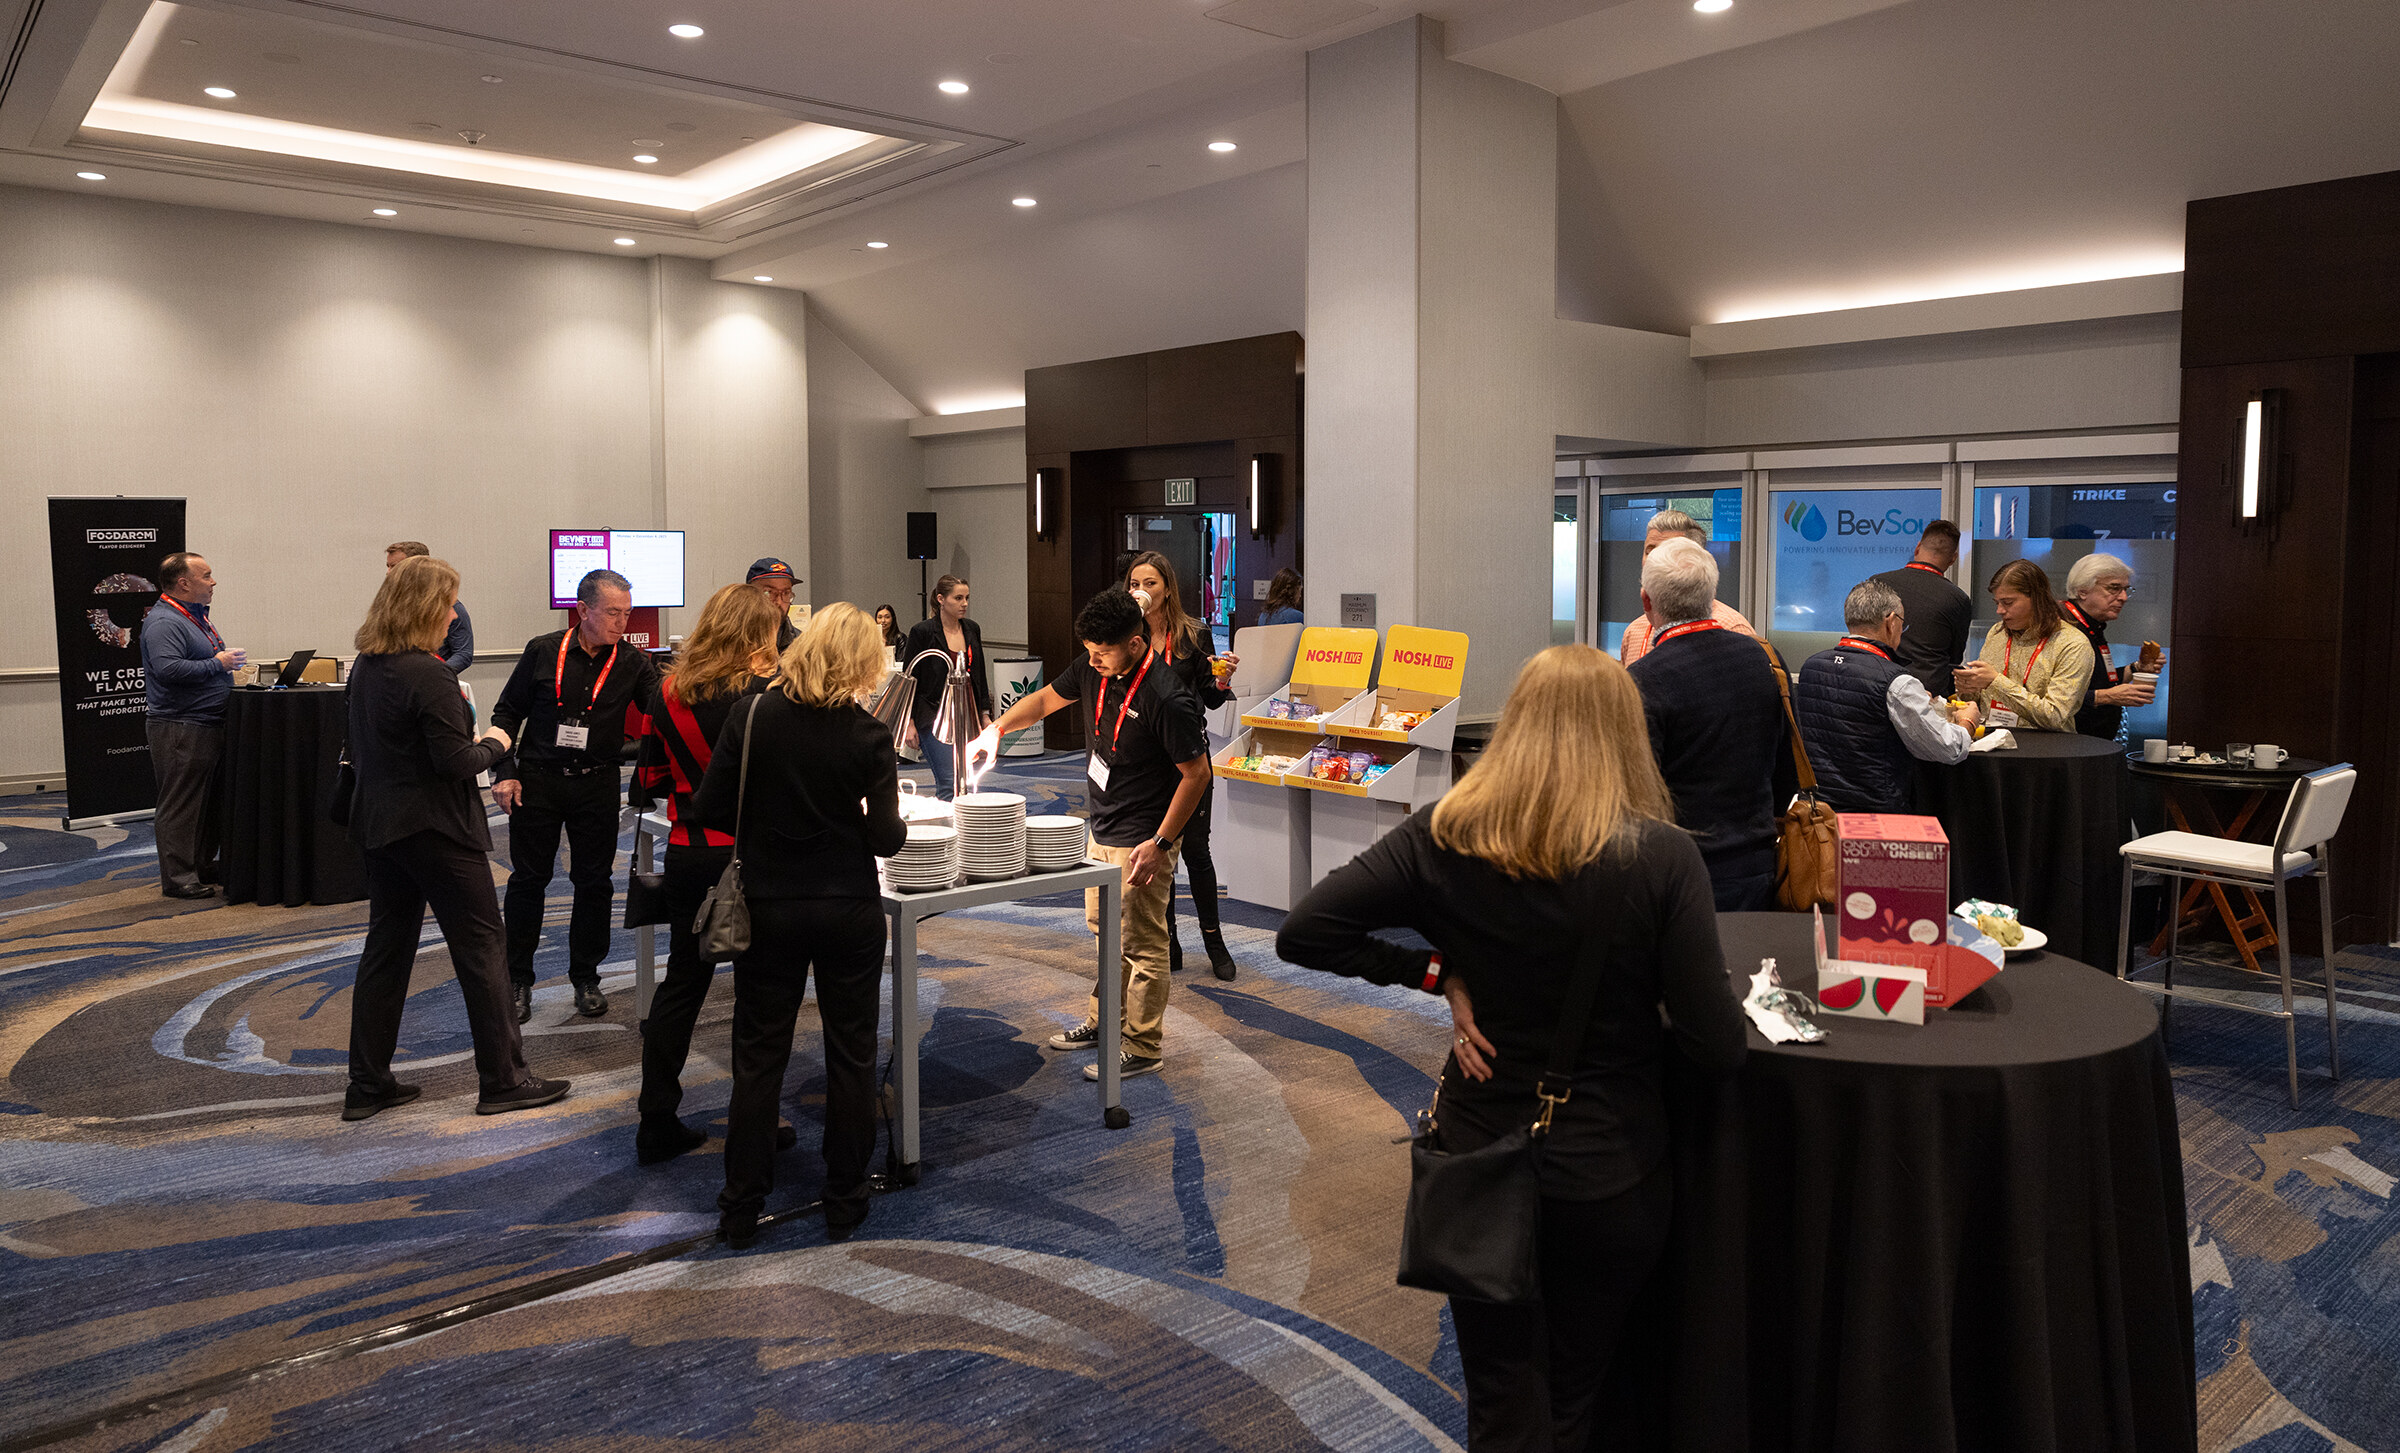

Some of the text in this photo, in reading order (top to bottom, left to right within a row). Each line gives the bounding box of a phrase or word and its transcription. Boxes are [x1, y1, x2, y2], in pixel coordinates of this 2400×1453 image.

[1171, 482, 1190, 502] EXIT
[1838, 508, 1941, 536] BevSou
[90, 531, 153, 540] FOODAROM
[1352, 614, 1363, 622] 271
[631, 633, 649, 644] LIVE
[1306, 650, 1362, 664] NOSH LIVE
[1393, 649, 1453, 669] NOSH LIVE
[1834, 656, 1844, 664] TS
[86, 668, 145, 682] WE CRE
[96, 679, 145, 692] FLAVO
[76, 702, 98, 710] THAT
[100, 698, 126, 708] MAKE
[100, 706, 150, 716] UNFORGETTA
[107, 744, 150, 755] Foodarom.c
[1322, 782, 1345, 790] DELICIOUS
[1842, 841, 1880, 850] ONCE
[1880, 842, 1908, 850] YOU
[1934, 844, 1946, 852] IT
[1842, 848, 1870, 857] YOU
[1890, 850, 1934, 860] UNSEE
